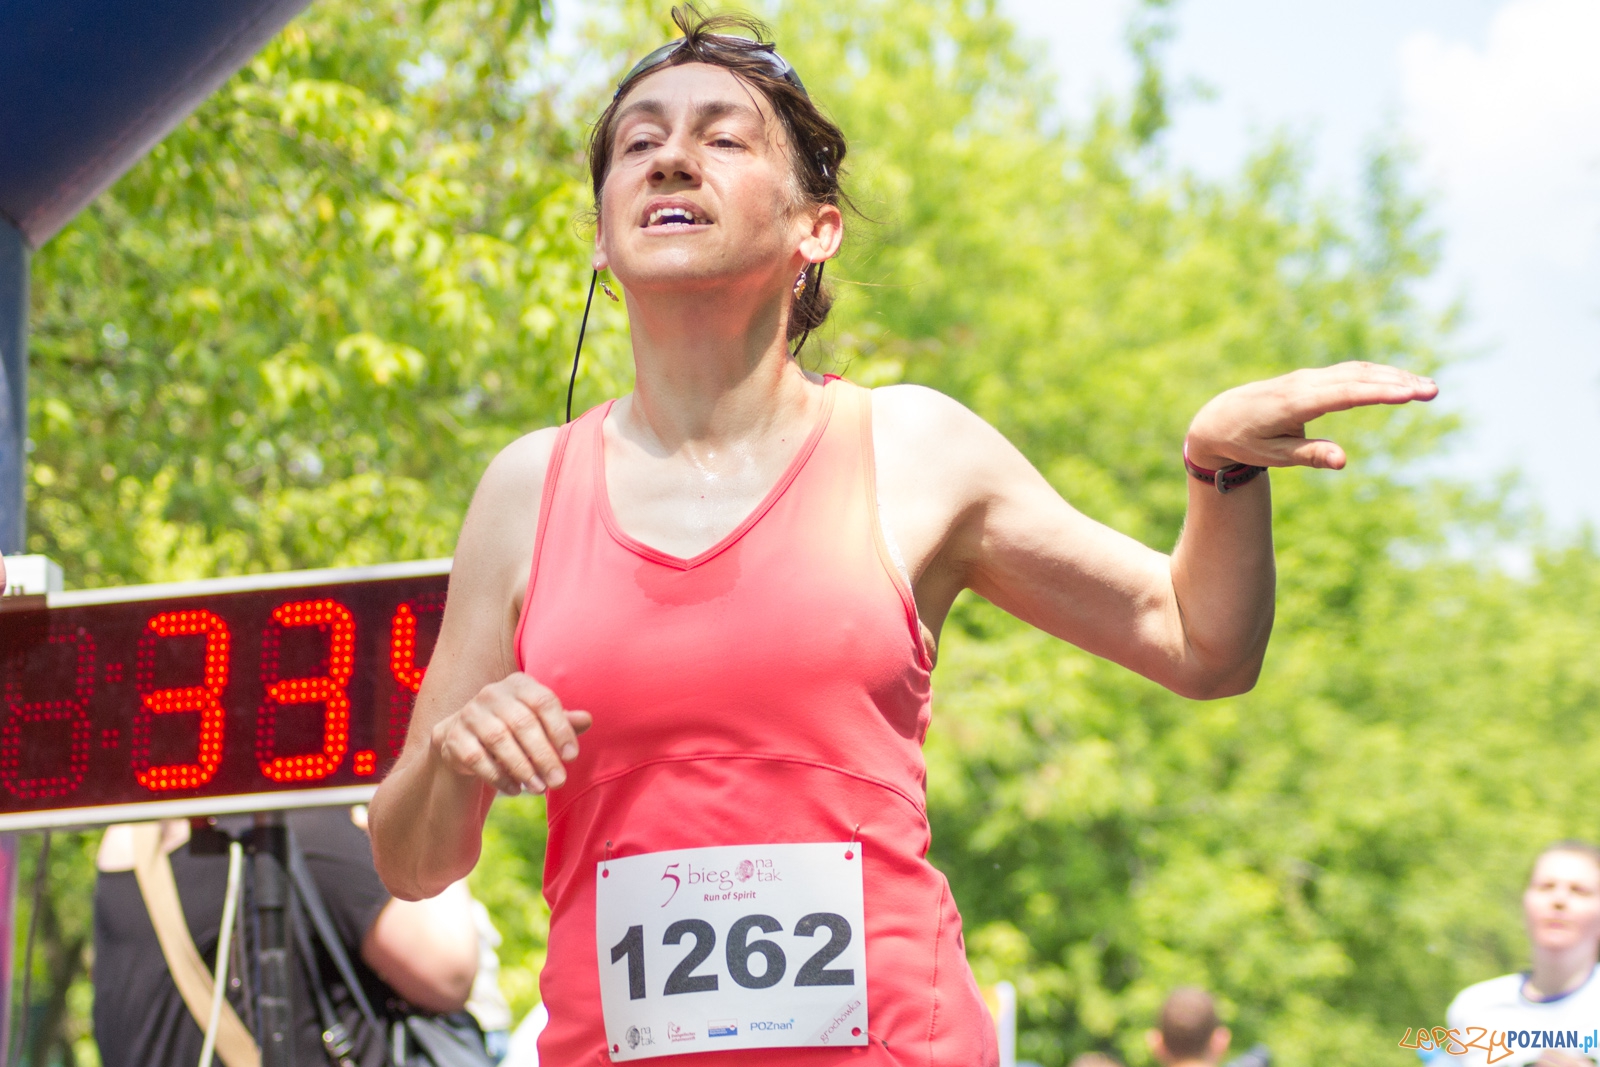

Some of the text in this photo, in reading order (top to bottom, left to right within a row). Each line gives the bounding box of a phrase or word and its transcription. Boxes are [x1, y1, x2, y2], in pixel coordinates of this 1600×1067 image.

[661, 858, 773, 908] 5 bieg na
[757, 868, 782, 882] tak
[703, 890, 756, 902] Run of Spirit
[610, 912, 855, 1001] 1262
